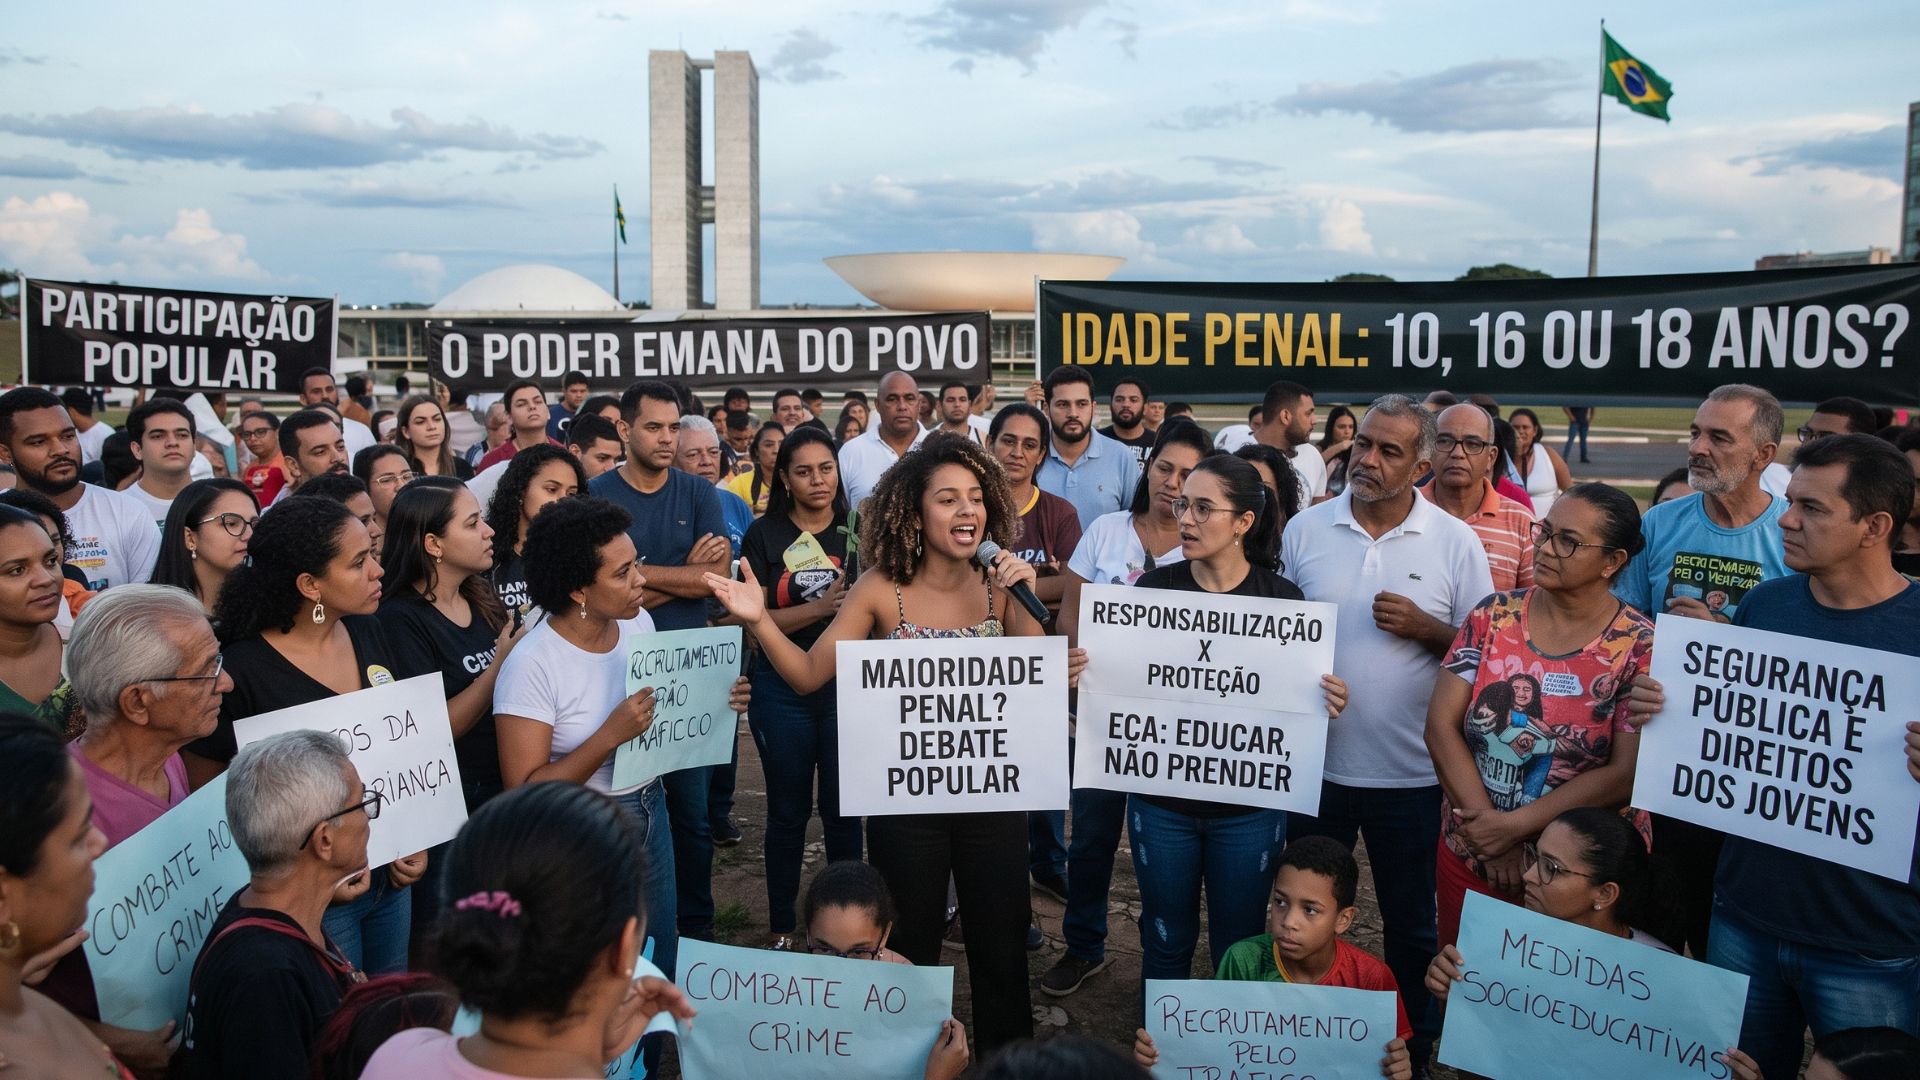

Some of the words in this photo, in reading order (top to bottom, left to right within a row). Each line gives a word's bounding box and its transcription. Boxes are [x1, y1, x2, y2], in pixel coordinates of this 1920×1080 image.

[42, 288, 315, 347] PARTICIPAÇÃO
[1062, 312, 1190, 366] IDADE
[1205, 313, 1369, 367] PENAL:
[1384, 311, 1452, 377] 10,
[1469, 311, 1526, 369] 16
[1542, 310, 1612, 369] OU
[1631, 307, 1692, 369] 18
[1708, 303, 1909, 369] ANOS?
[84, 340, 277, 390] POPULAR
[442, 333, 468, 378] O
[483, 332, 620, 378] PODER
[634, 328, 784, 377] EMANA
[799, 327, 853, 372] DO
[868, 324, 978, 371] POVO
[1093, 601, 1322, 645] RESPONSABILIZAÇÃO
[861, 655, 1044, 689] MAIORIDADE
[1197, 639, 1211, 662] X
[1147, 663, 1260, 697] PROTEÇÃO
[1683, 641, 1886, 714] SEGURANÇA
[383, 709, 418, 741] DA
[900, 693, 1006, 724] PENAL?
[1692, 682, 1832, 746] PÚBLICA
[1844, 715, 1866, 753] E
[900, 729, 1008, 760] DEBATE
[1108, 712, 1167, 744] ECA:
[1176, 718, 1291, 761] EDUCAR,
[1700, 728, 1853, 794] DIREITOS
[888, 764, 1019, 797] POPULAR
[1104, 743, 1158, 779] NÃO
[1167, 753, 1292, 792] PRENDER
[1672, 763, 1736, 809] DOS
[1744, 782, 1875, 845] JOVENS
[92, 842, 200, 956] COMBATE
[208, 820, 232, 861] AO
[686, 962, 842, 1009] COMBATE
[864, 984, 906, 1014] AO
[1153, 994, 1369, 1042] RECRUTAMENTO
[1228, 1040, 1297, 1066] PELO
